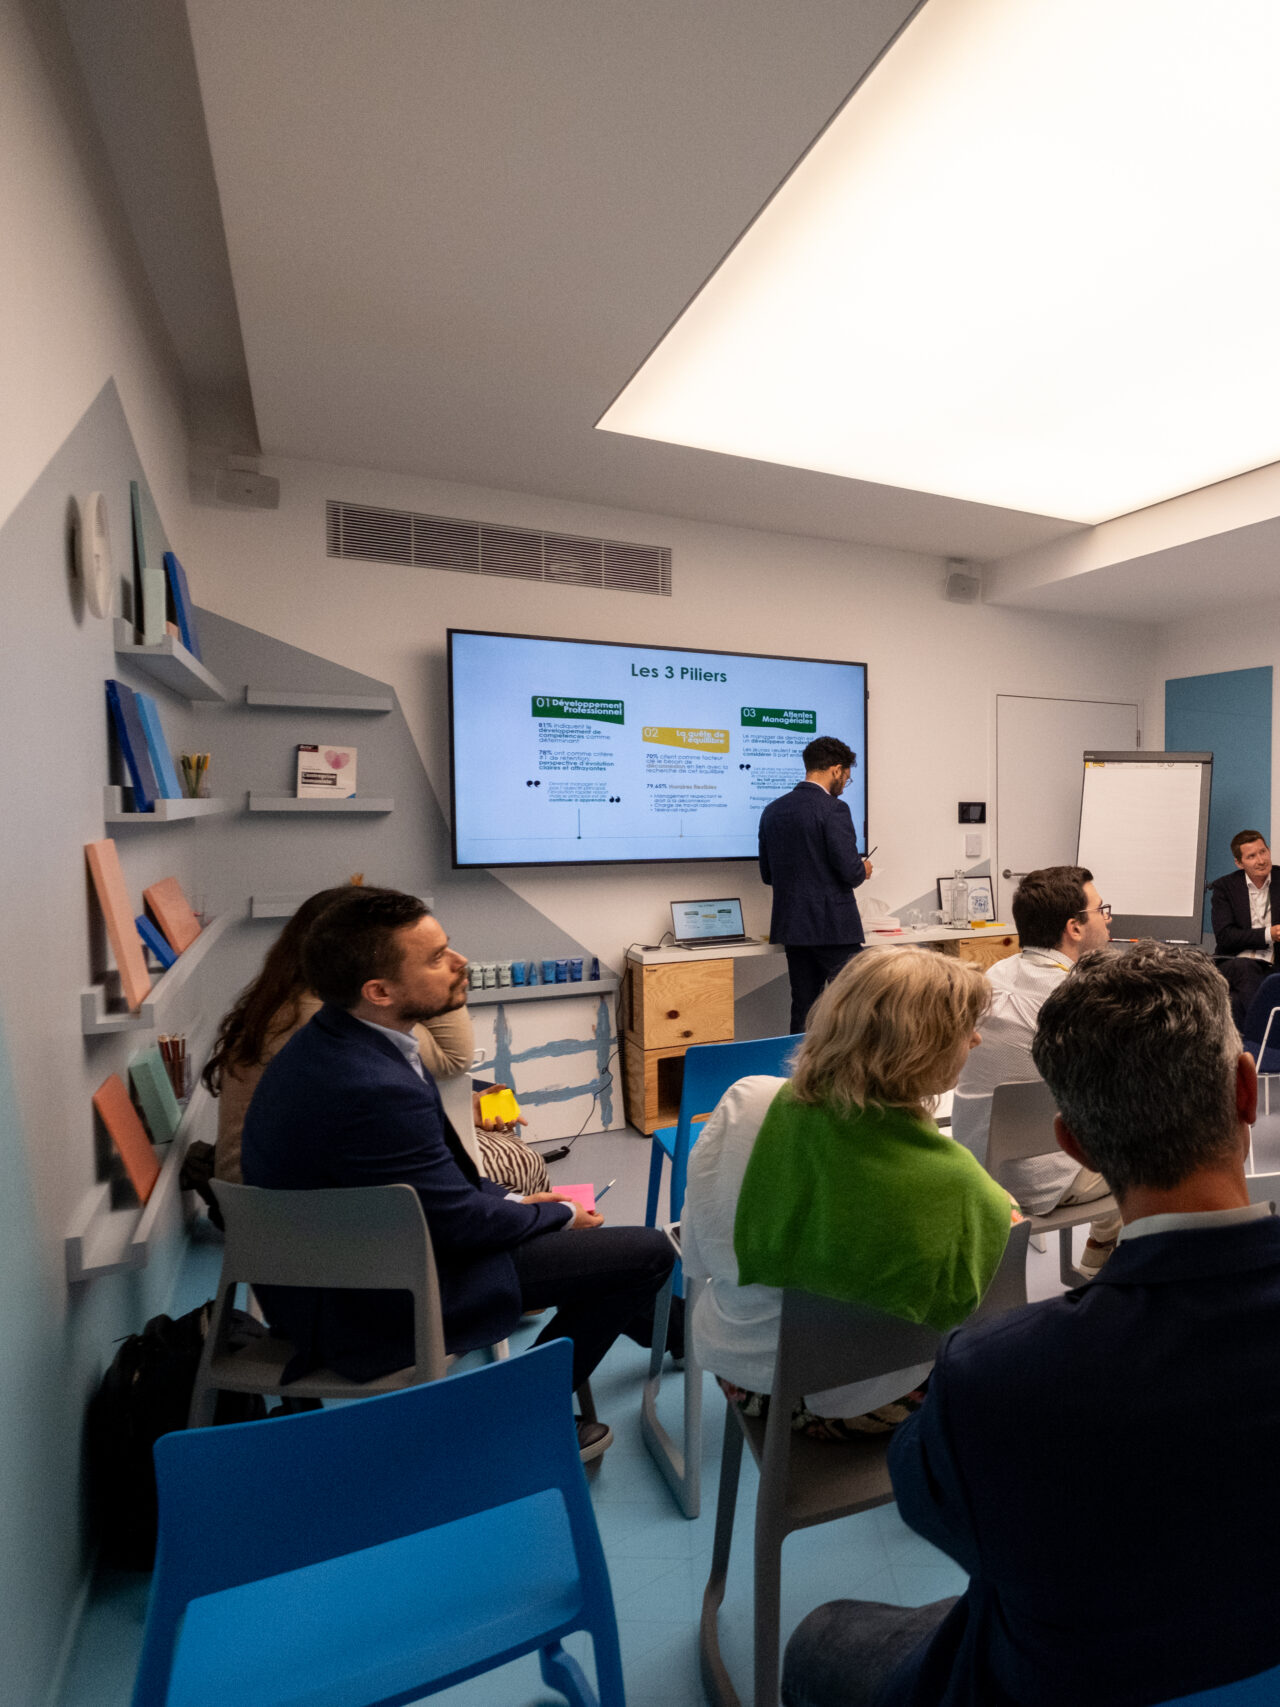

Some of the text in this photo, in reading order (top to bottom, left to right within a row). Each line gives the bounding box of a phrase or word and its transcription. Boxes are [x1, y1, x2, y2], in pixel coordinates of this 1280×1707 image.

[631, 663, 728, 683] Les 3 Piliers
[536, 697, 622, 709] 01 Développement
[563, 706, 622, 716] Professionnel
[743, 708, 813, 719] 03 Attentes
[644, 728, 659, 738] 02
